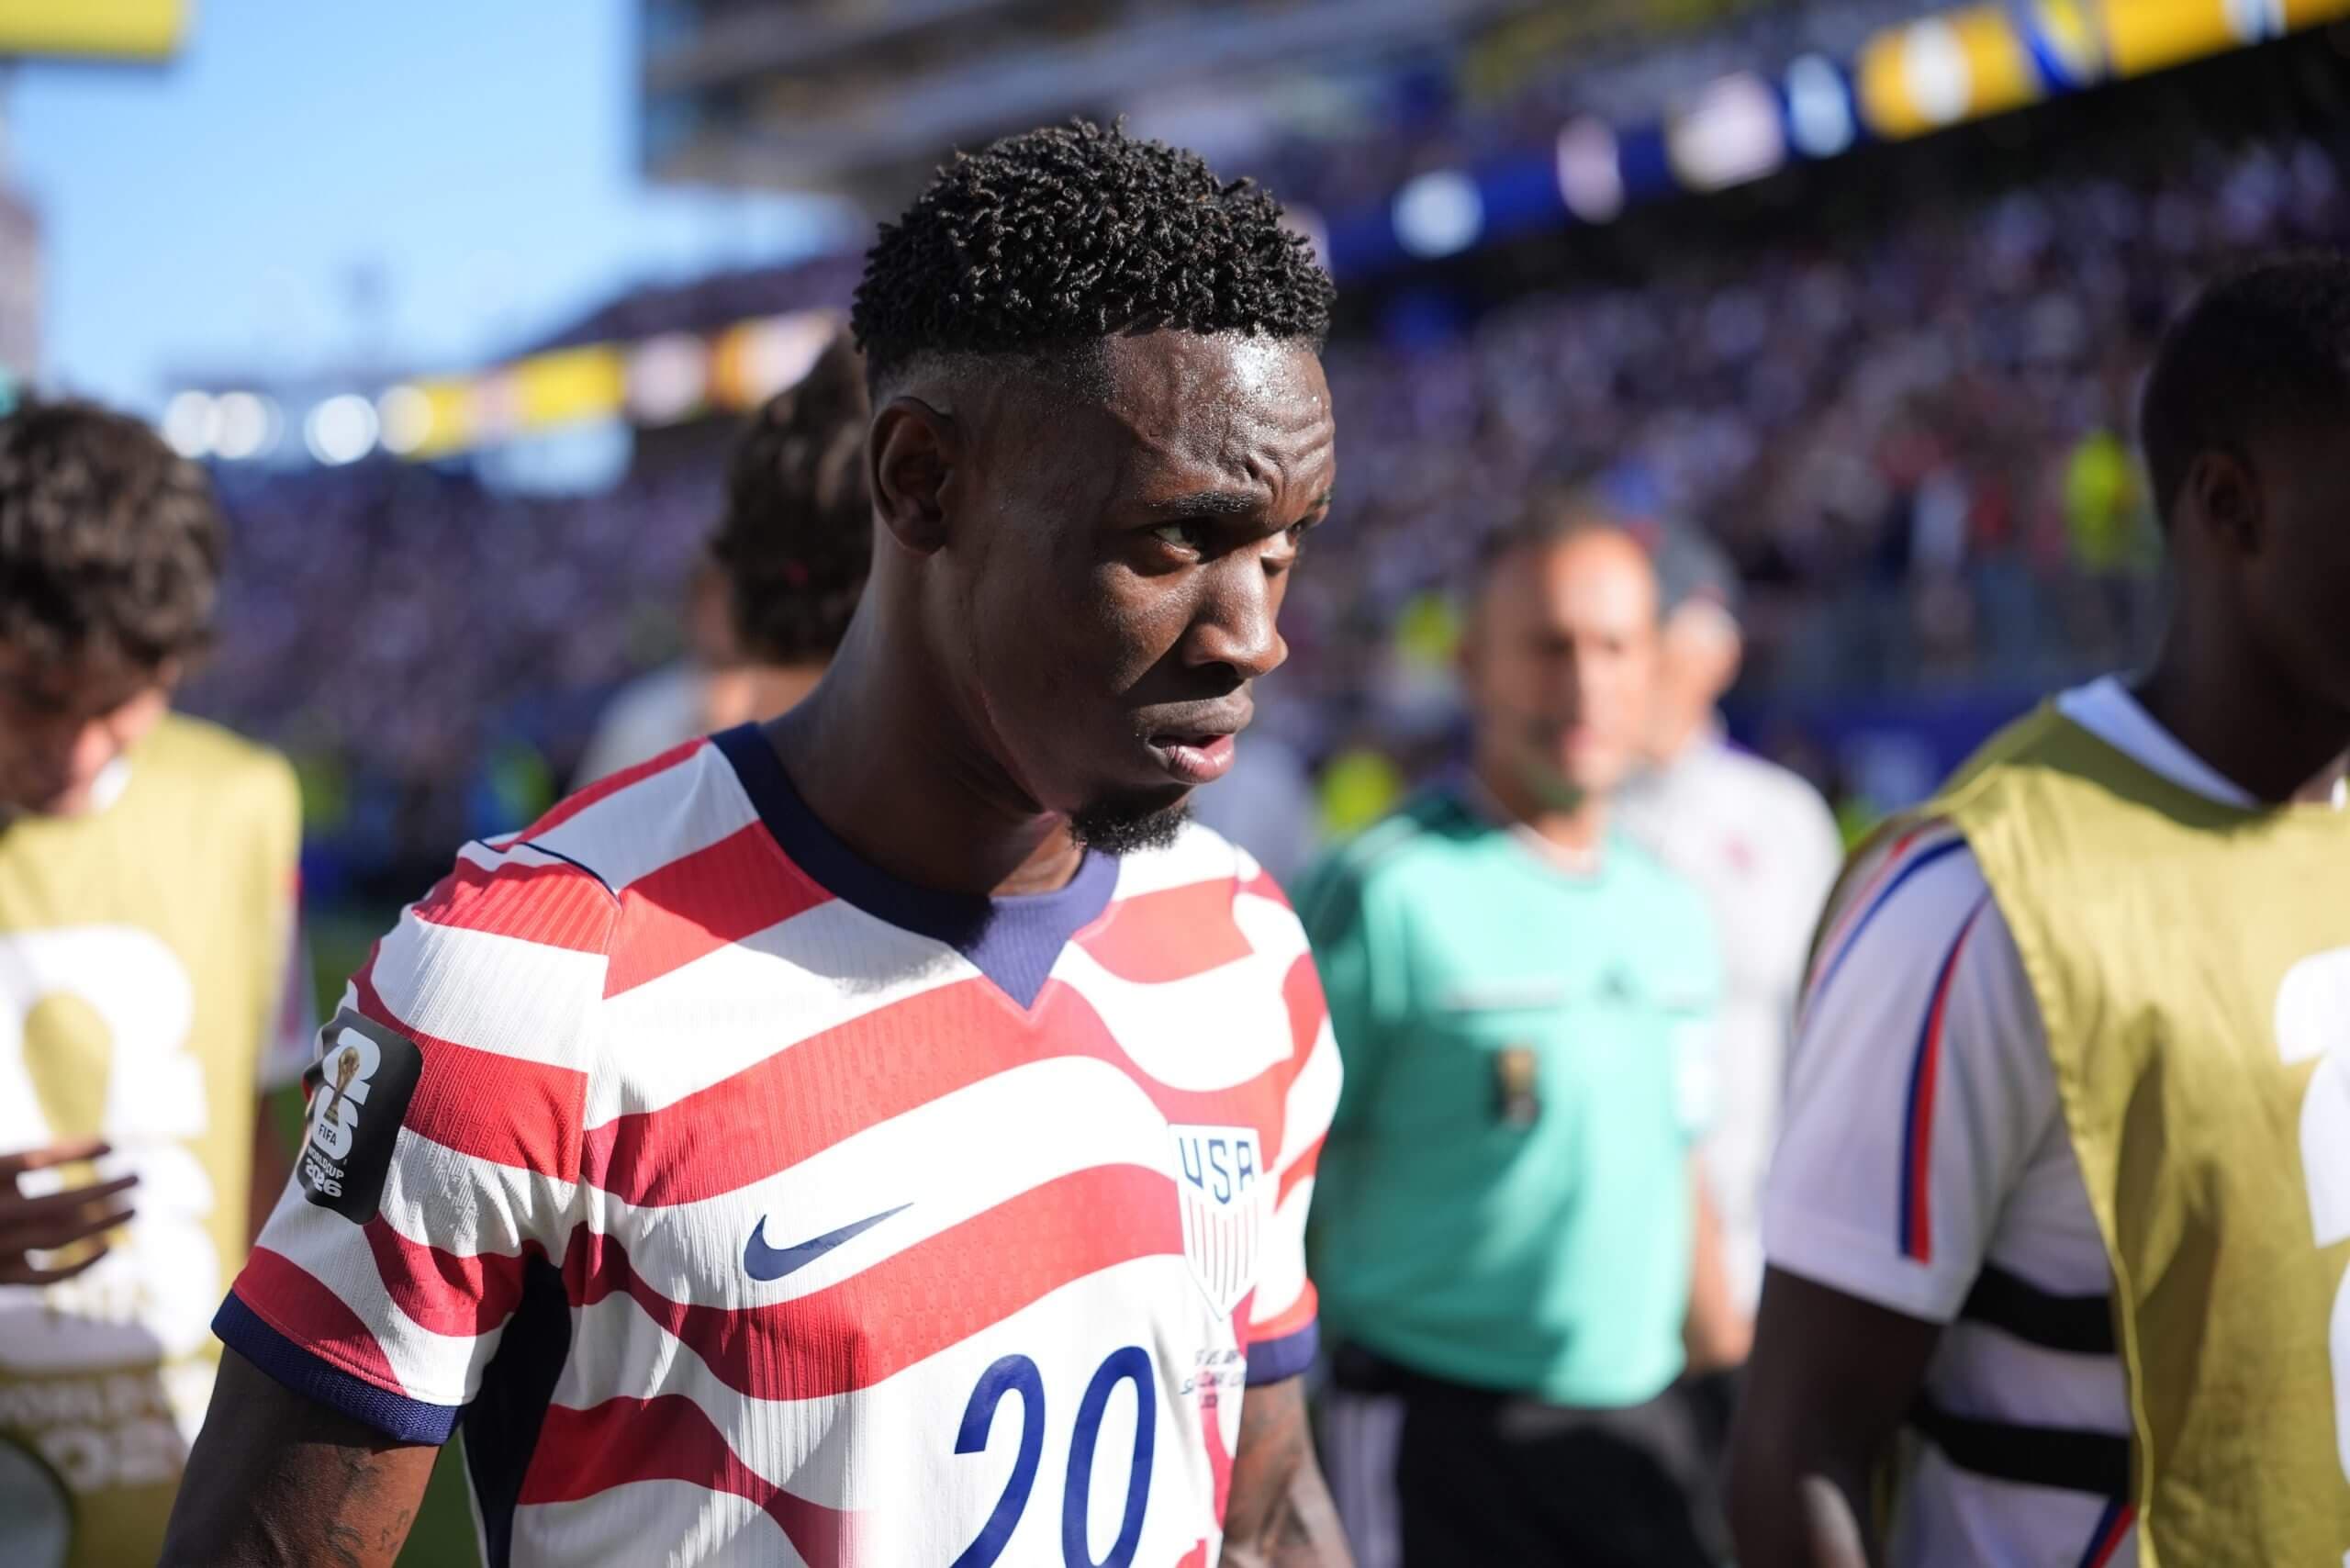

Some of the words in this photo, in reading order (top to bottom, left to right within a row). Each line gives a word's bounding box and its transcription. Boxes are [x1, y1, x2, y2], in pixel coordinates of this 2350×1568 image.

[319, 1123, 337, 1147] FIFA
[305, 1158, 343, 1198] 2026
[325, 1163, 345, 1180] CUP
[1179, 1137, 1255, 1204] USA
[951, 1346, 1157, 1568] 20
